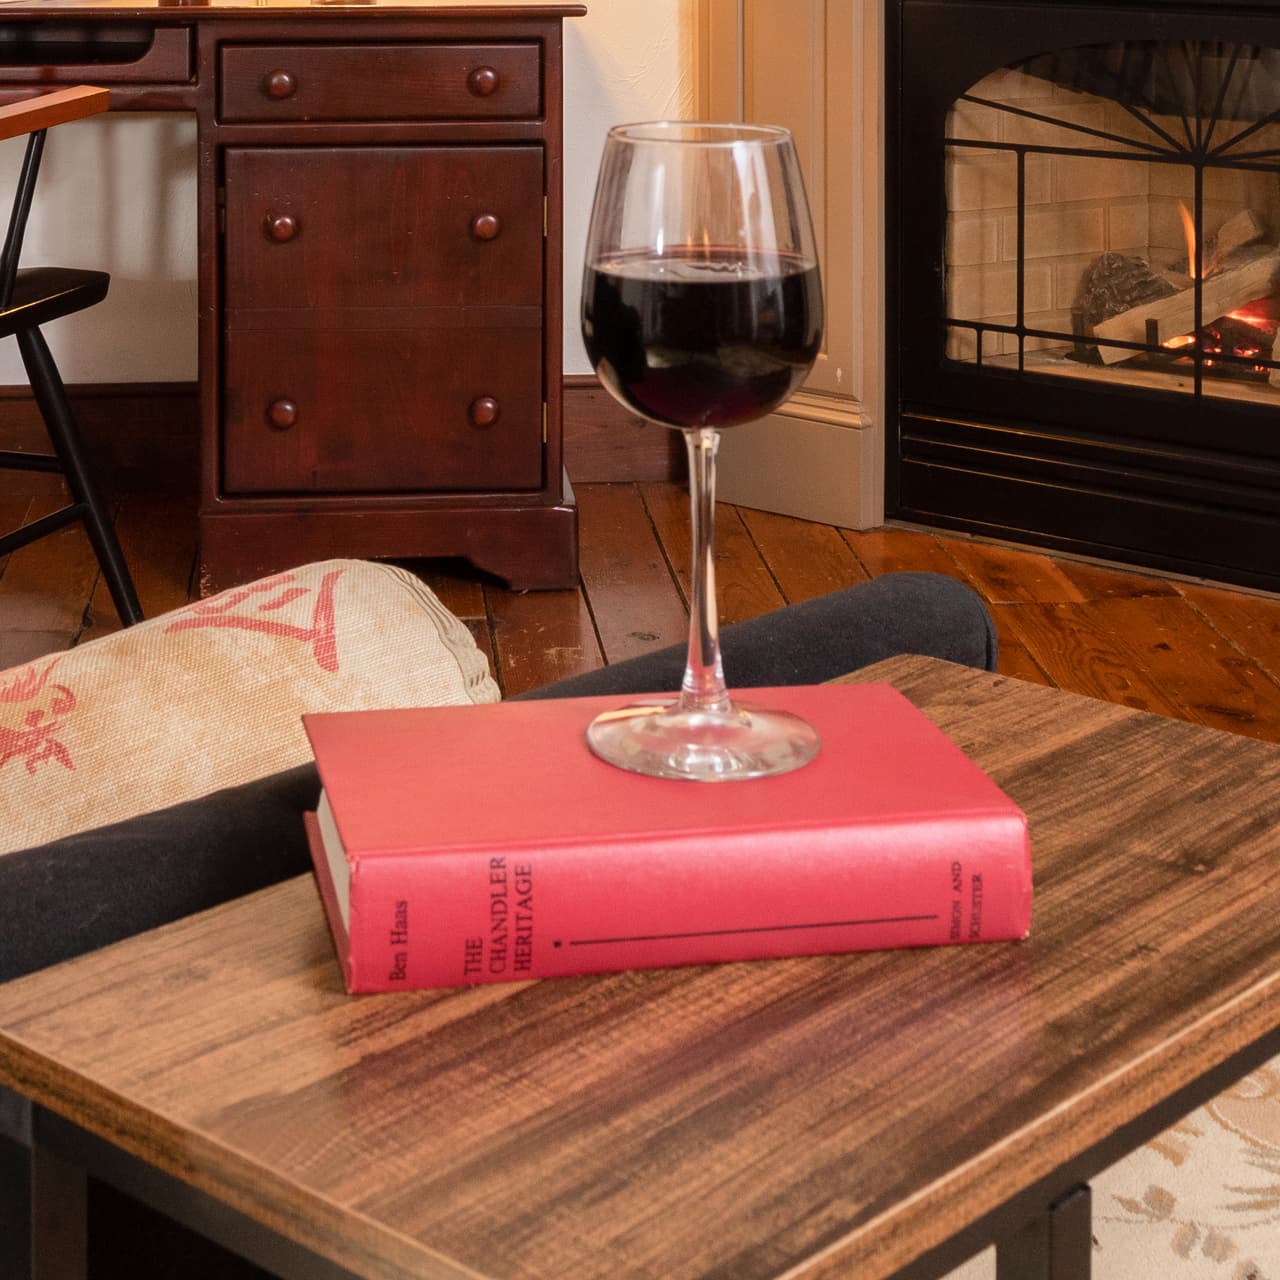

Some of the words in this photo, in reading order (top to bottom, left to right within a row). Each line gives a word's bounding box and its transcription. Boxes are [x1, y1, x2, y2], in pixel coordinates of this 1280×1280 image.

[951, 861, 962, 893] AND
[390, 900, 408, 945] Haas
[489, 857, 508, 974] CHANDLER
[513, 864, 533, 971] HERITAGE
[389, 952, 408, 981] Ben
[464, 937, 483, 976] THE
